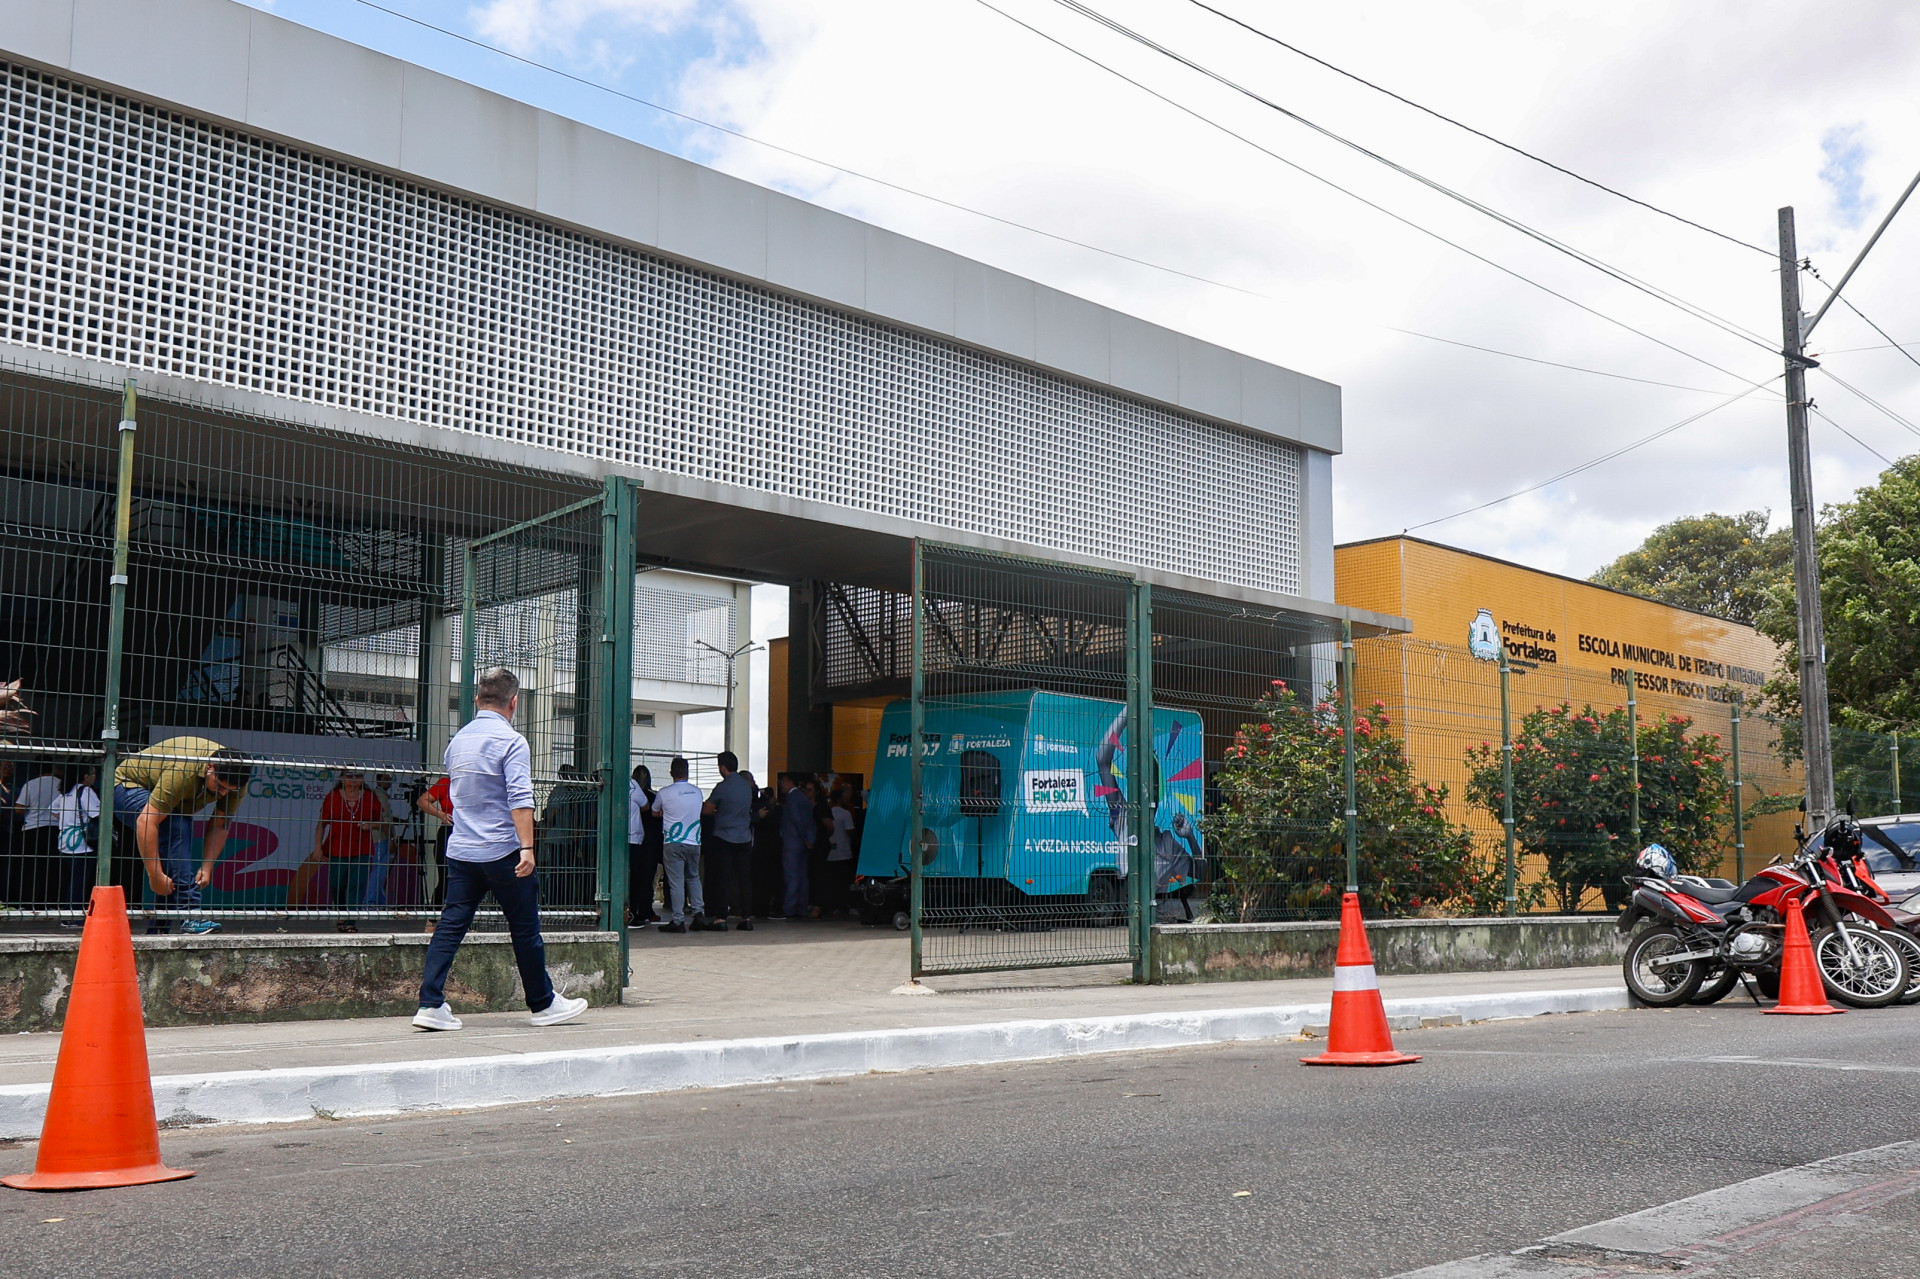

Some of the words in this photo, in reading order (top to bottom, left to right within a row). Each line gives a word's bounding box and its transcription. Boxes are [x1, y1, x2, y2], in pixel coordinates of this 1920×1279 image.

[1502, 620, 1544, 640] Prefeitura
[1545, 629, 1556, 643] de
[1502, 636, 1557, 664] Fortaleza
[1578, 633, 1620, 658] ESCOLA
[1622, 643, 1677, 669] MUNICIPAL
[1678, 654, 1692, 672] DE
[1693, 657, 1724, 679] TEMPO
[1726, 665, 1766, 687] INTEGRAL
[1670, 678, 1705, 700] PRISCO
[889, 733, 941, 744] Forteza
[966, 739, 1011, 749] FORTALEZA
[886, 744, 908, 758] FM
[909, 743, 941, 757] 0.7
[247, 778, 306, 799] Casa
[1032, 776, 1077, 790] Fortaleza
[1033, 790, 1051, 804] FM
[1024, 838, 1033, 853] A
[1033, 839, 1055, 853] VOZ
[1055, 840, 1069, 853] DA
[1070, 840, 1104, 854] NOSSA
